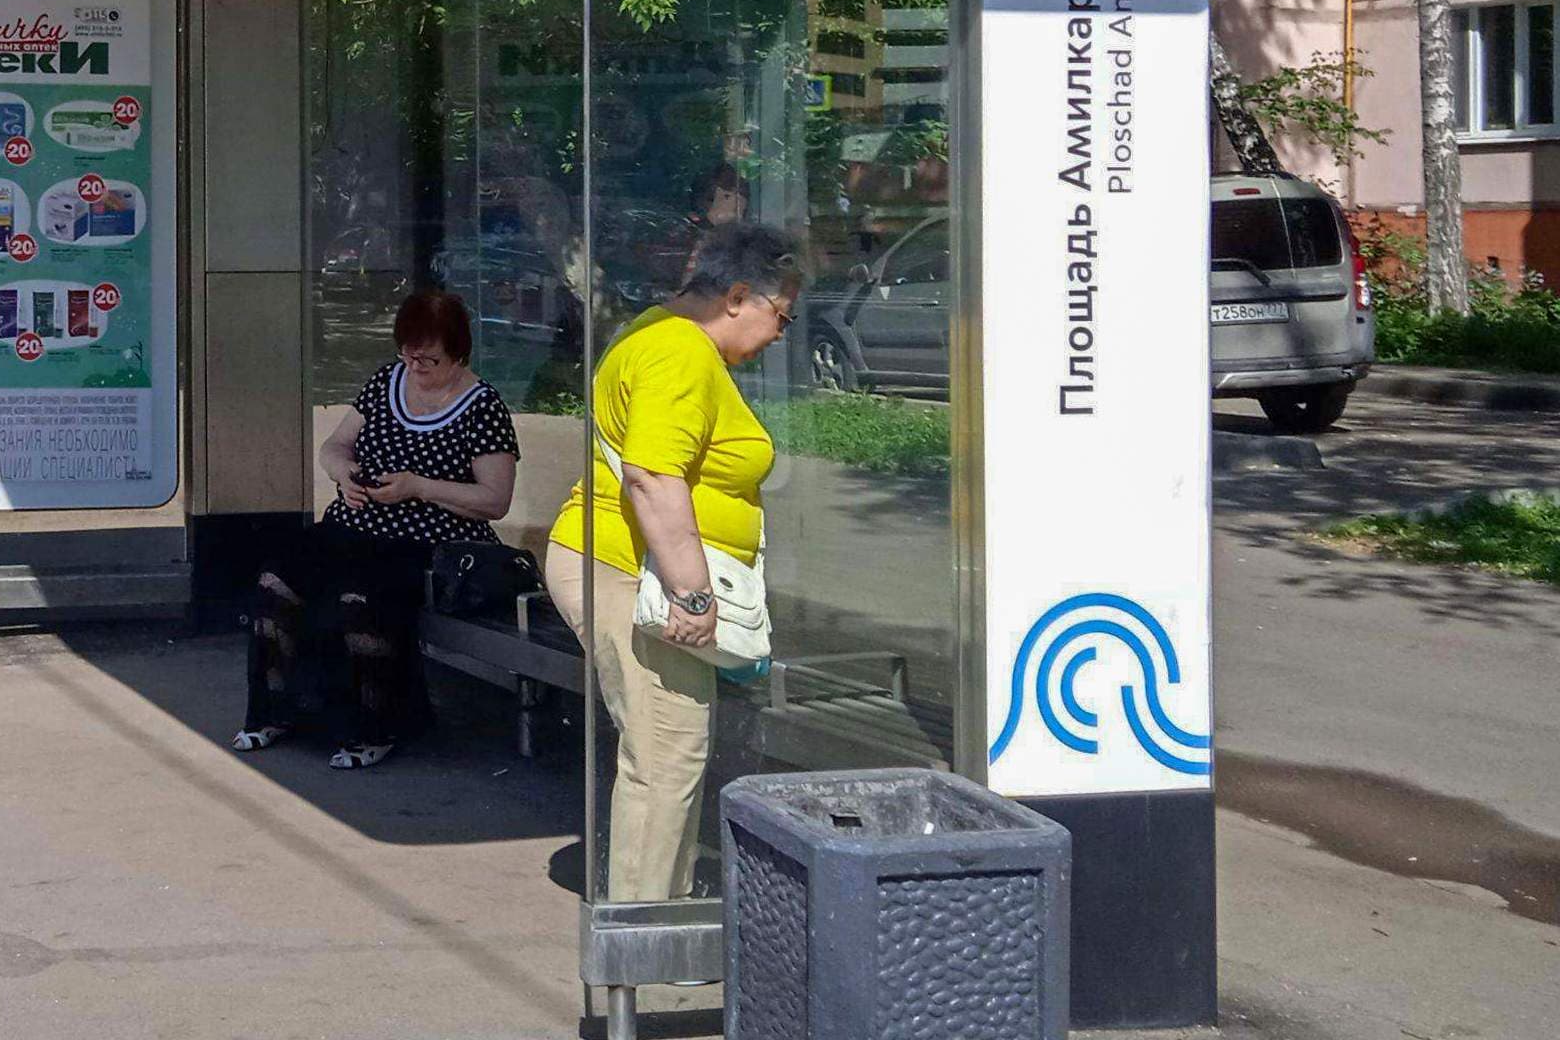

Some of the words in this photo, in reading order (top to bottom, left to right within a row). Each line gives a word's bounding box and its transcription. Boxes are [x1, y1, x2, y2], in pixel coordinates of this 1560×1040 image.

[23, 42, 59, 52] аптек
[1107, 49, 1131, 194] Ploschad
[1059, 203, 1098, 415] Площадь
[48, 428, 137, 452] НЕОБХОДИМО
[41, 456, 137, 480] СПЕЦИАЛИСТА
